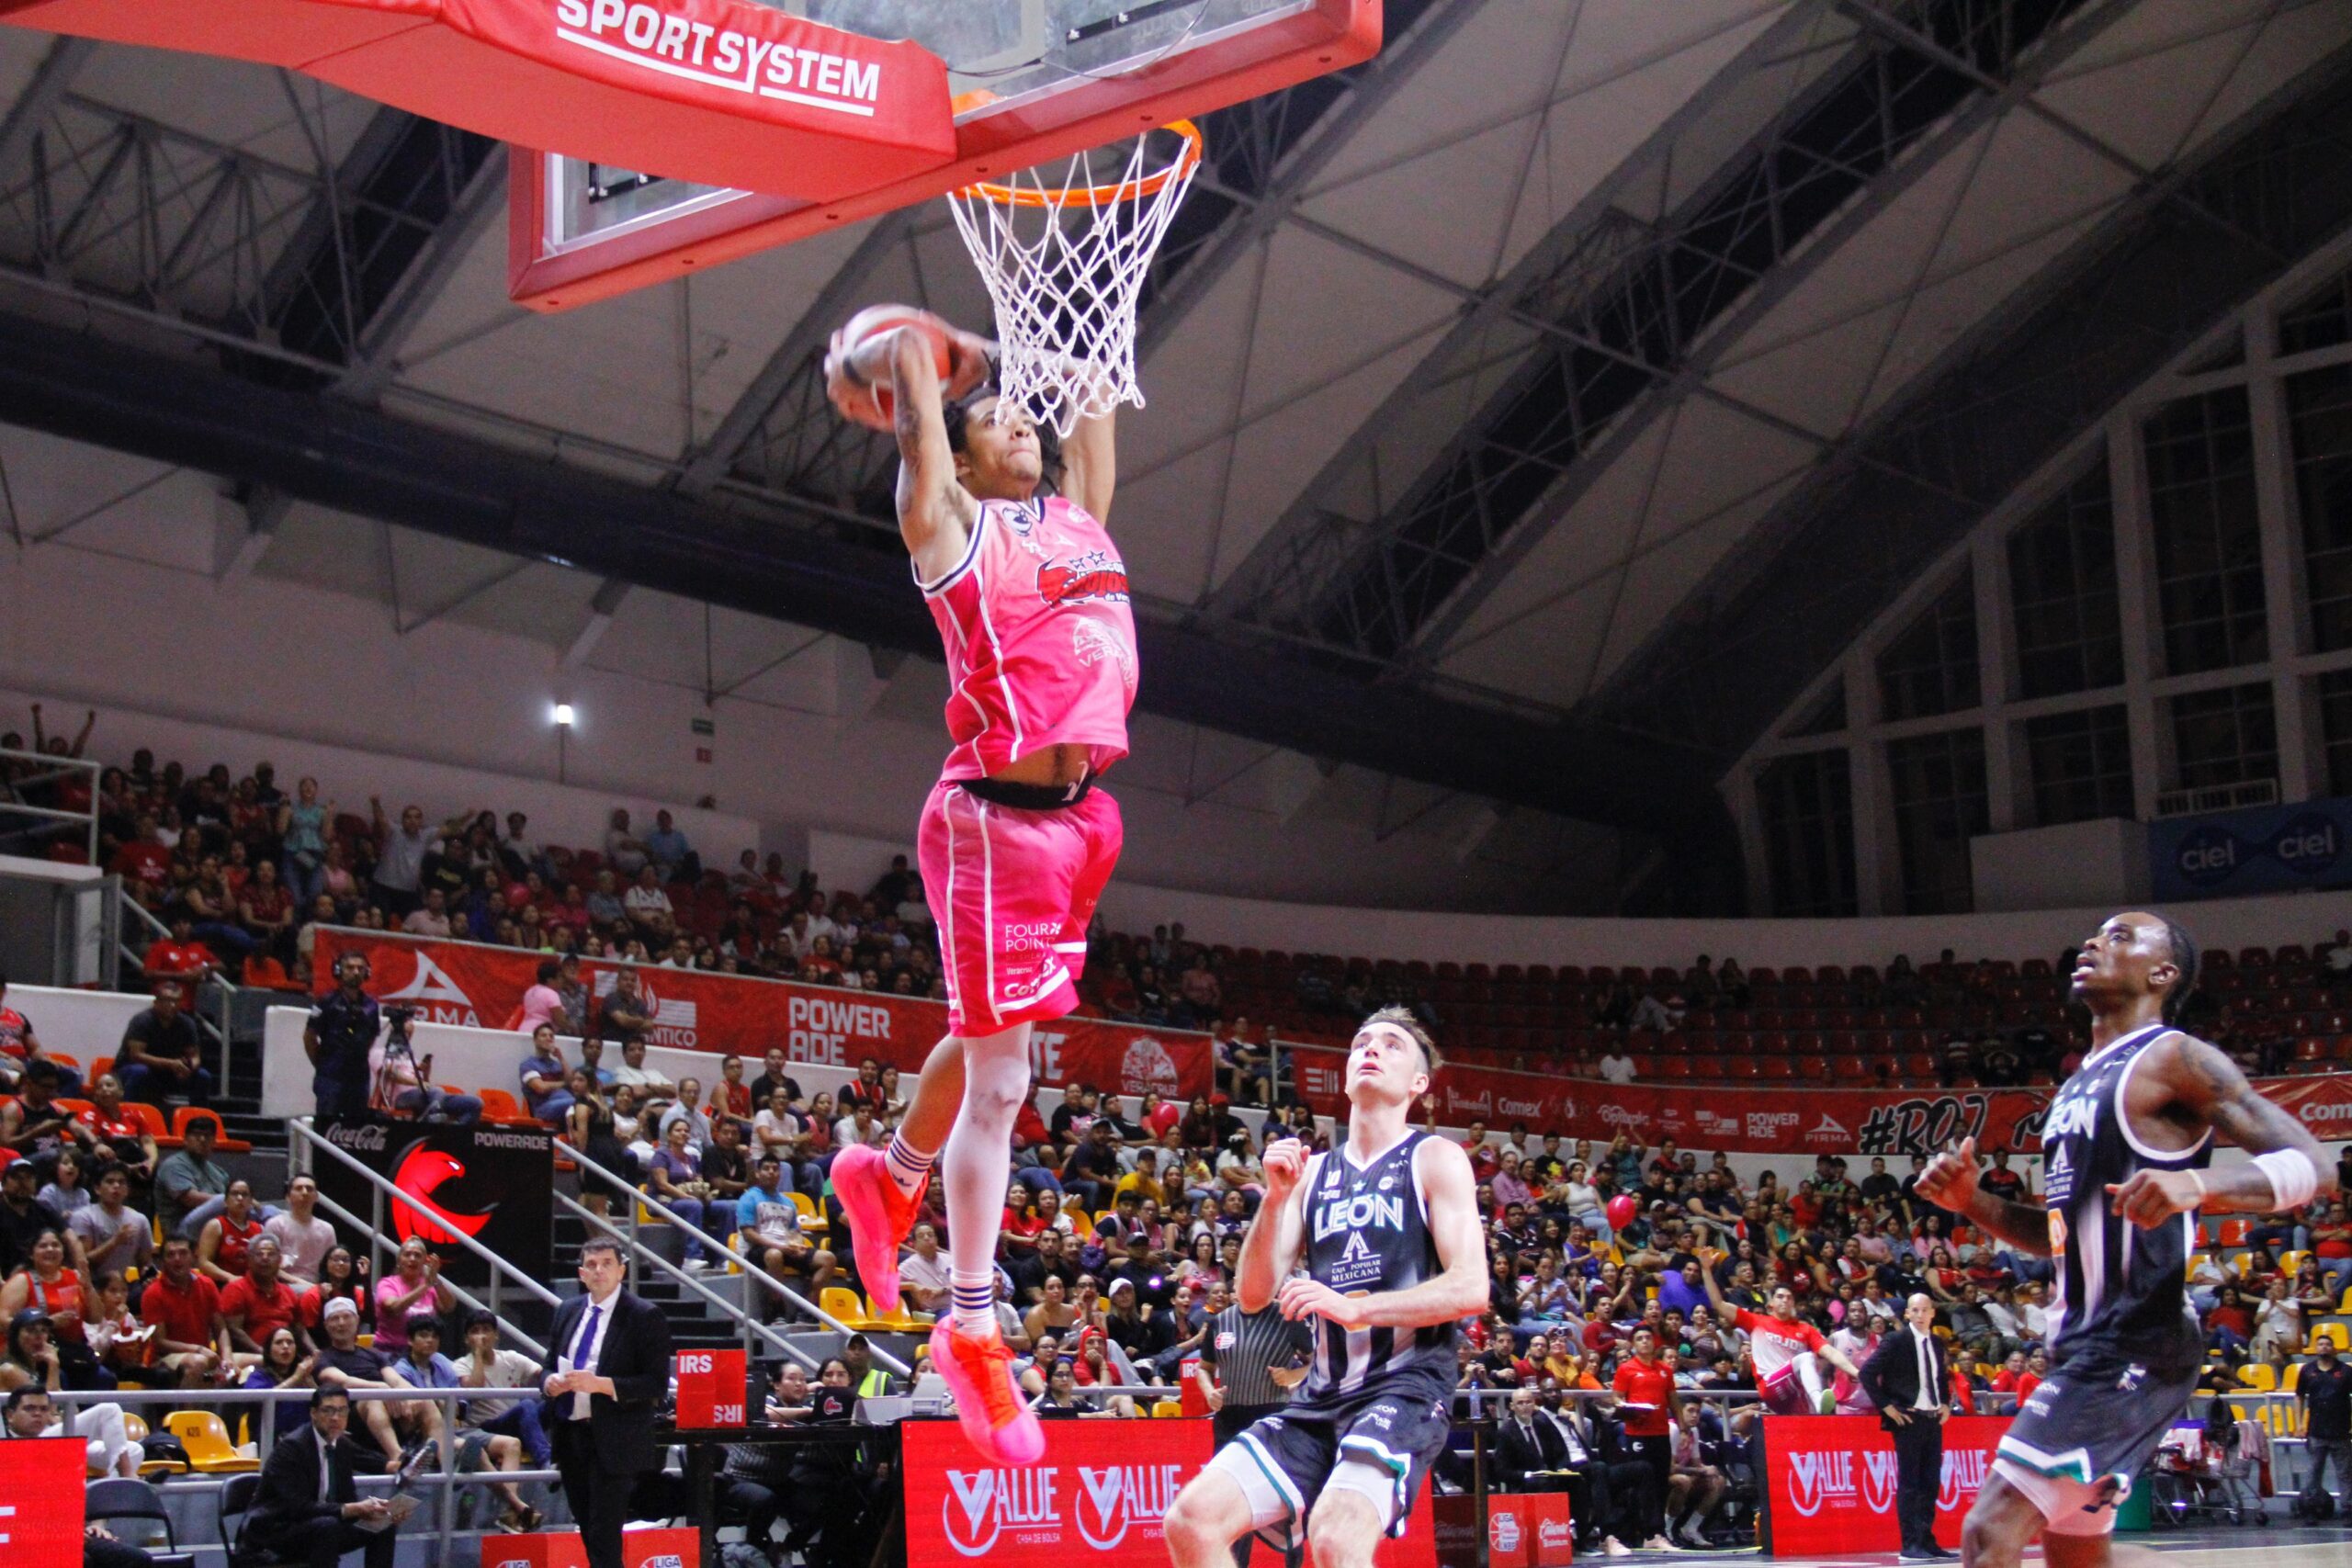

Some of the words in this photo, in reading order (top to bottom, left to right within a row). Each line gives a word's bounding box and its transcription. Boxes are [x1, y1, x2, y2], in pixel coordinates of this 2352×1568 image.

[2278, 825, 2335, 859] ciel
[2182, 840, 2235, 871] ciel
[1005, 922, 1049, 938] FOUR
[789, 996, 891, 1040] POWER
[789, 1029, 846, 1066] ADE
[1498, 1096, 1544, 1118] Comex
[1747, 1111, 1800, 1127] POWER
[474, 1132, 549, 1151] POWERADE
[1804, 1132, 1853, 1143] PIRMA
[1331, 1267, 1381, 1282] MEXICANA
[1351, 1259, 1381, 1270] POPULAR
[679, 1354, 713, 1374] IRS
[1788, 1451, 1856, 1506] VALUE
[945, 1467, 1060, 1541] VALUE
[655, 1555, 681, 1568] LIGA
